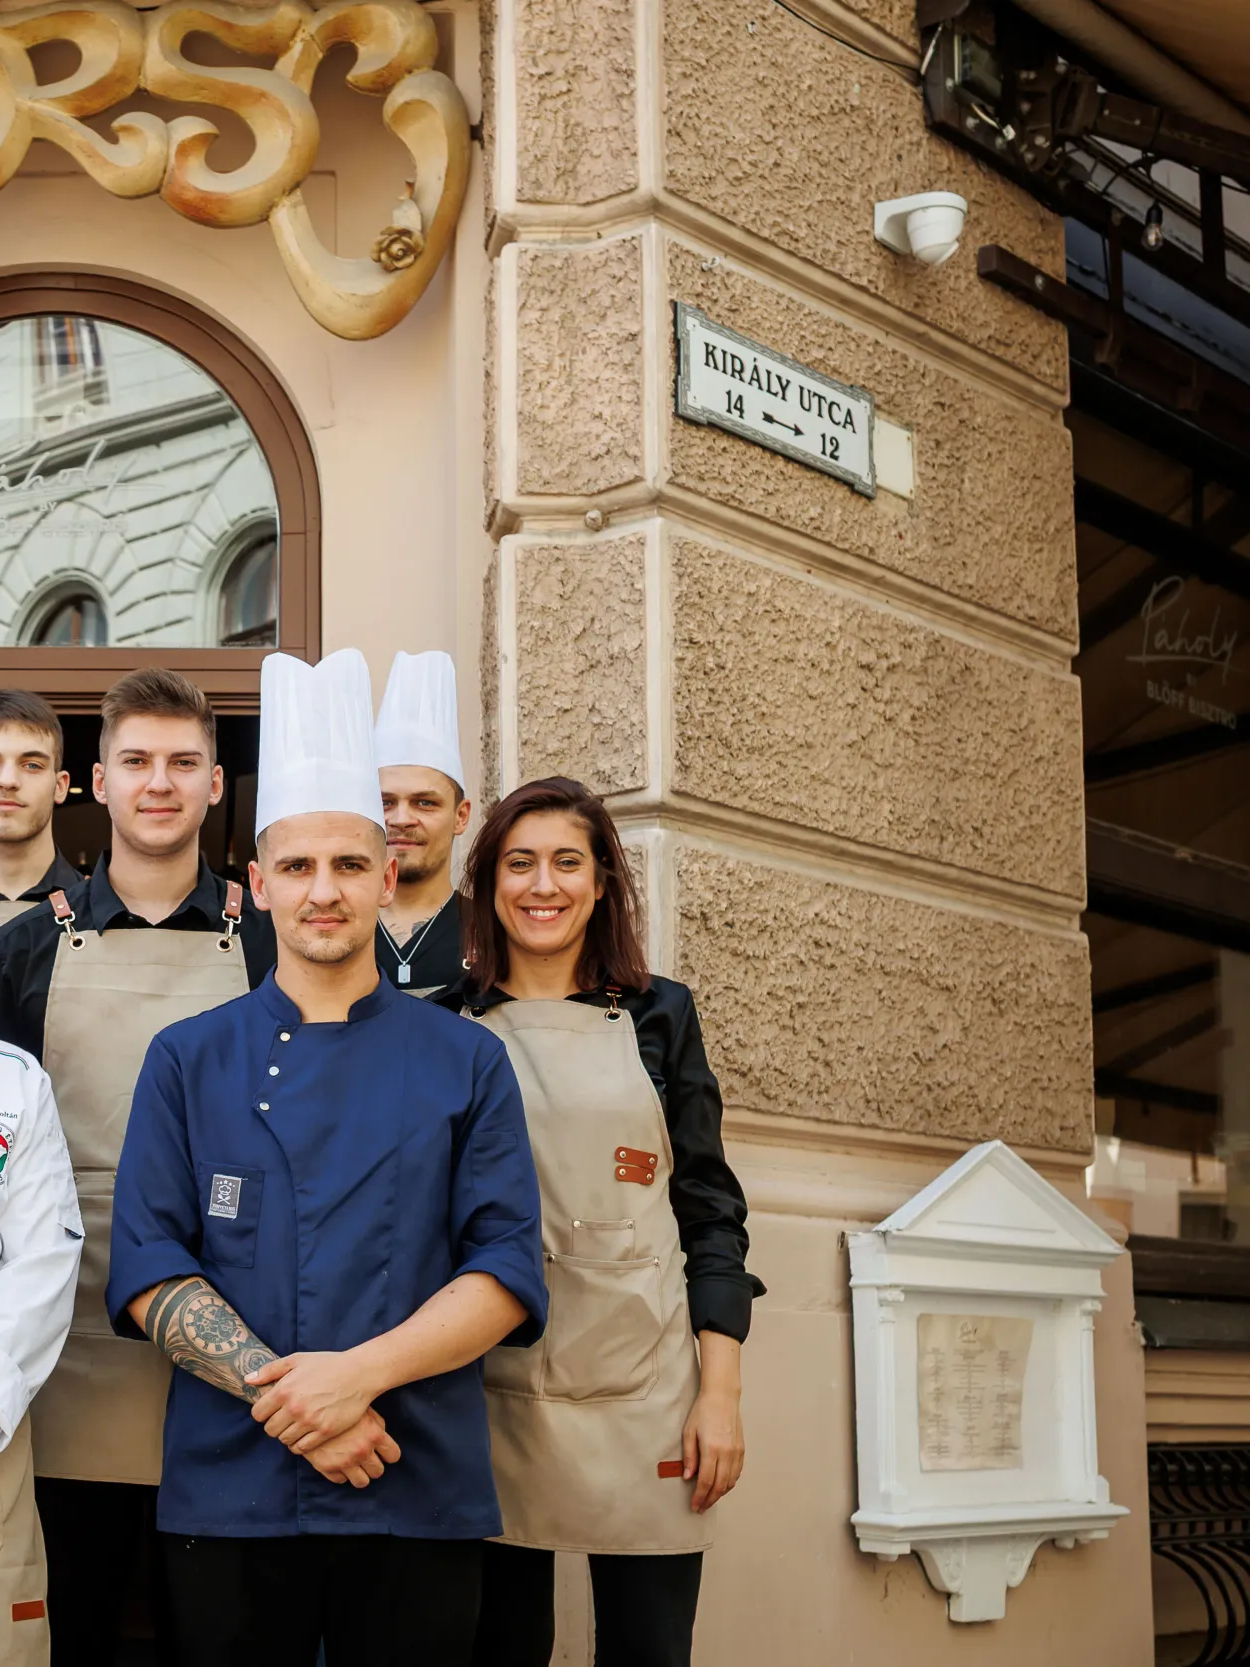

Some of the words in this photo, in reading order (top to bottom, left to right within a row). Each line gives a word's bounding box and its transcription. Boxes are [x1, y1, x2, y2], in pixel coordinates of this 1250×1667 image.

[703, 341, 791, 402] KIRÁLY
[798, 384, 857, 434] UTCA
[725, 389, 745, 420] 14
[819, 433, 840, 461] 12
[1138, 574, 1239, 685] Páholy
[1146, 679, 1186, 709] BLÖFF
